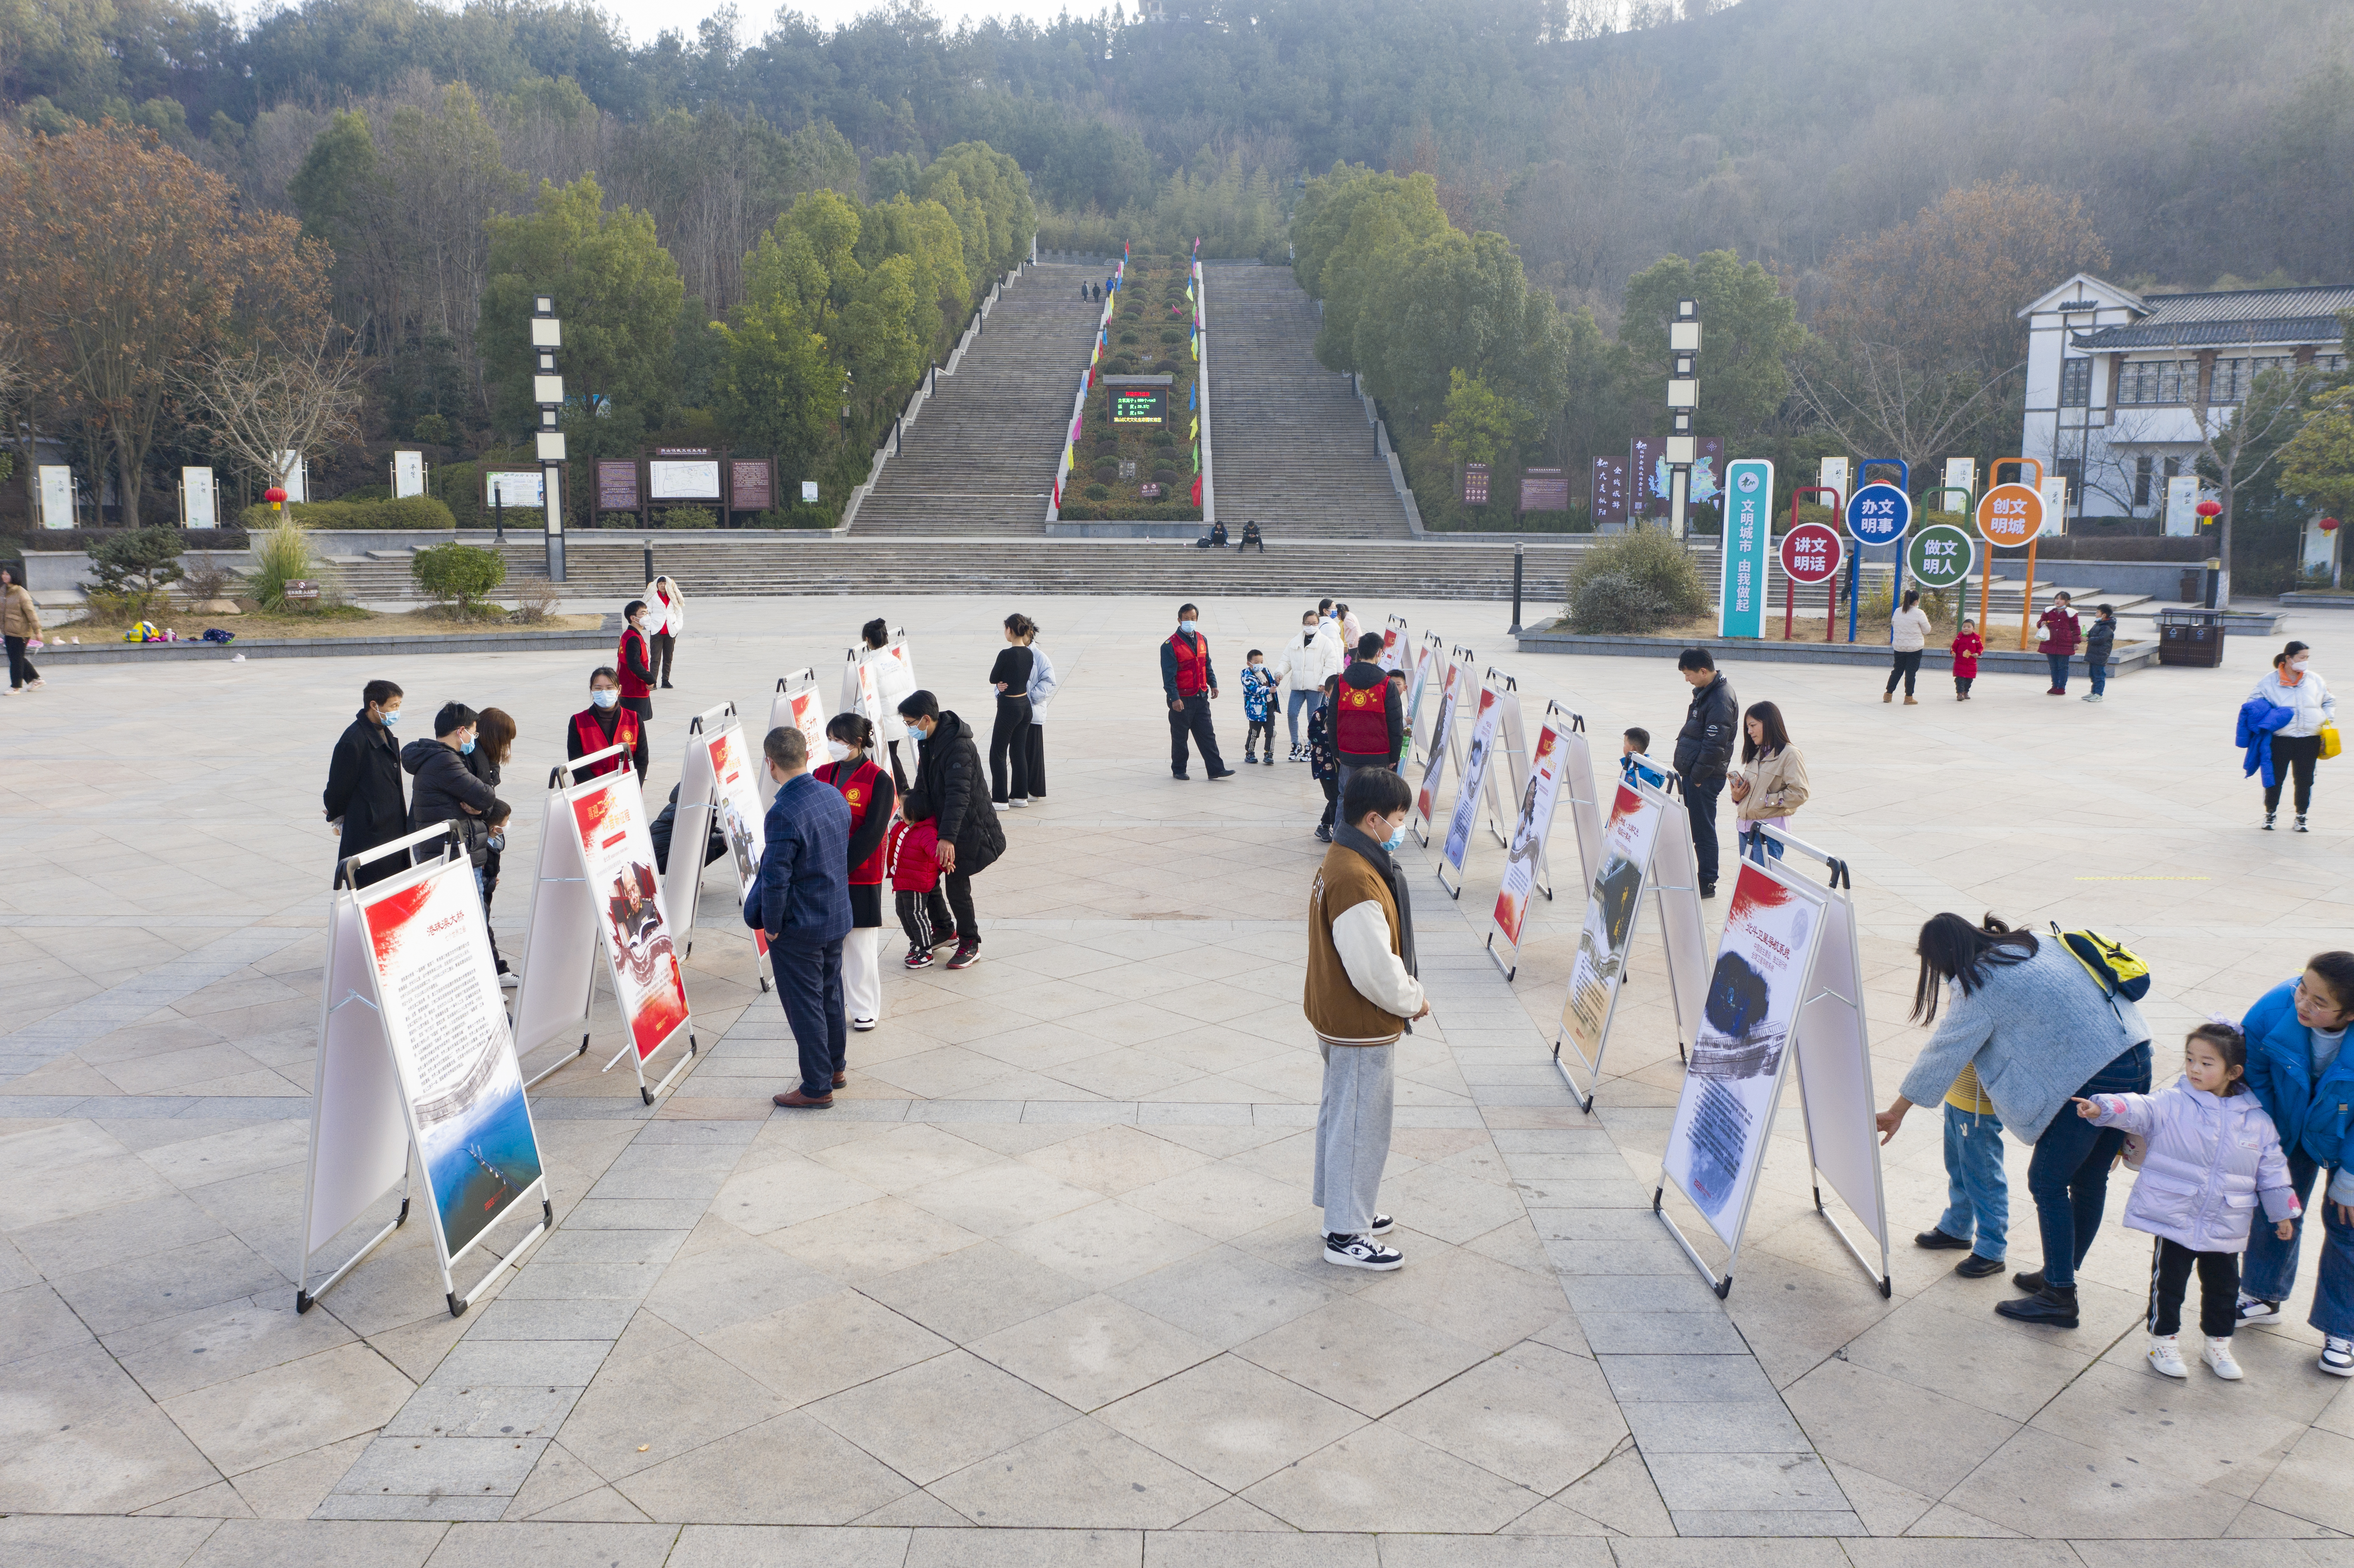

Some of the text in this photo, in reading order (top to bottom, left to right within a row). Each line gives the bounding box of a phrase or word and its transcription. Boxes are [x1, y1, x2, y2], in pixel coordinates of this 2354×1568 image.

[1862, 499, 1894, 515] 办文
[1993, 498, 2027, 515] 创文
[1739, 499, 1755, 553] 文明城市
[1861, 518, 1893, 533] 明事
[1991, 518, 2025, 535] 明城
[1795, 537, 1827, 553] 讲文
[1924, 539, 1958, 556] 做文
[1794, 556, 1825, 571] 明话
[1923, 559, 1955, 575] 明人
[1736, 559, 1750, 612] 由我做起
[587, 793, 618, 820] 喜迎二十大
[601, 809, 631, 834] 科普新征程
[427, 910, 464, 936] 港珠澳大桥
[1746, 923, 1790, 960] 北斗卫星导航系统
[1751, 952, 1774, 972] 全球卫星导航系统
